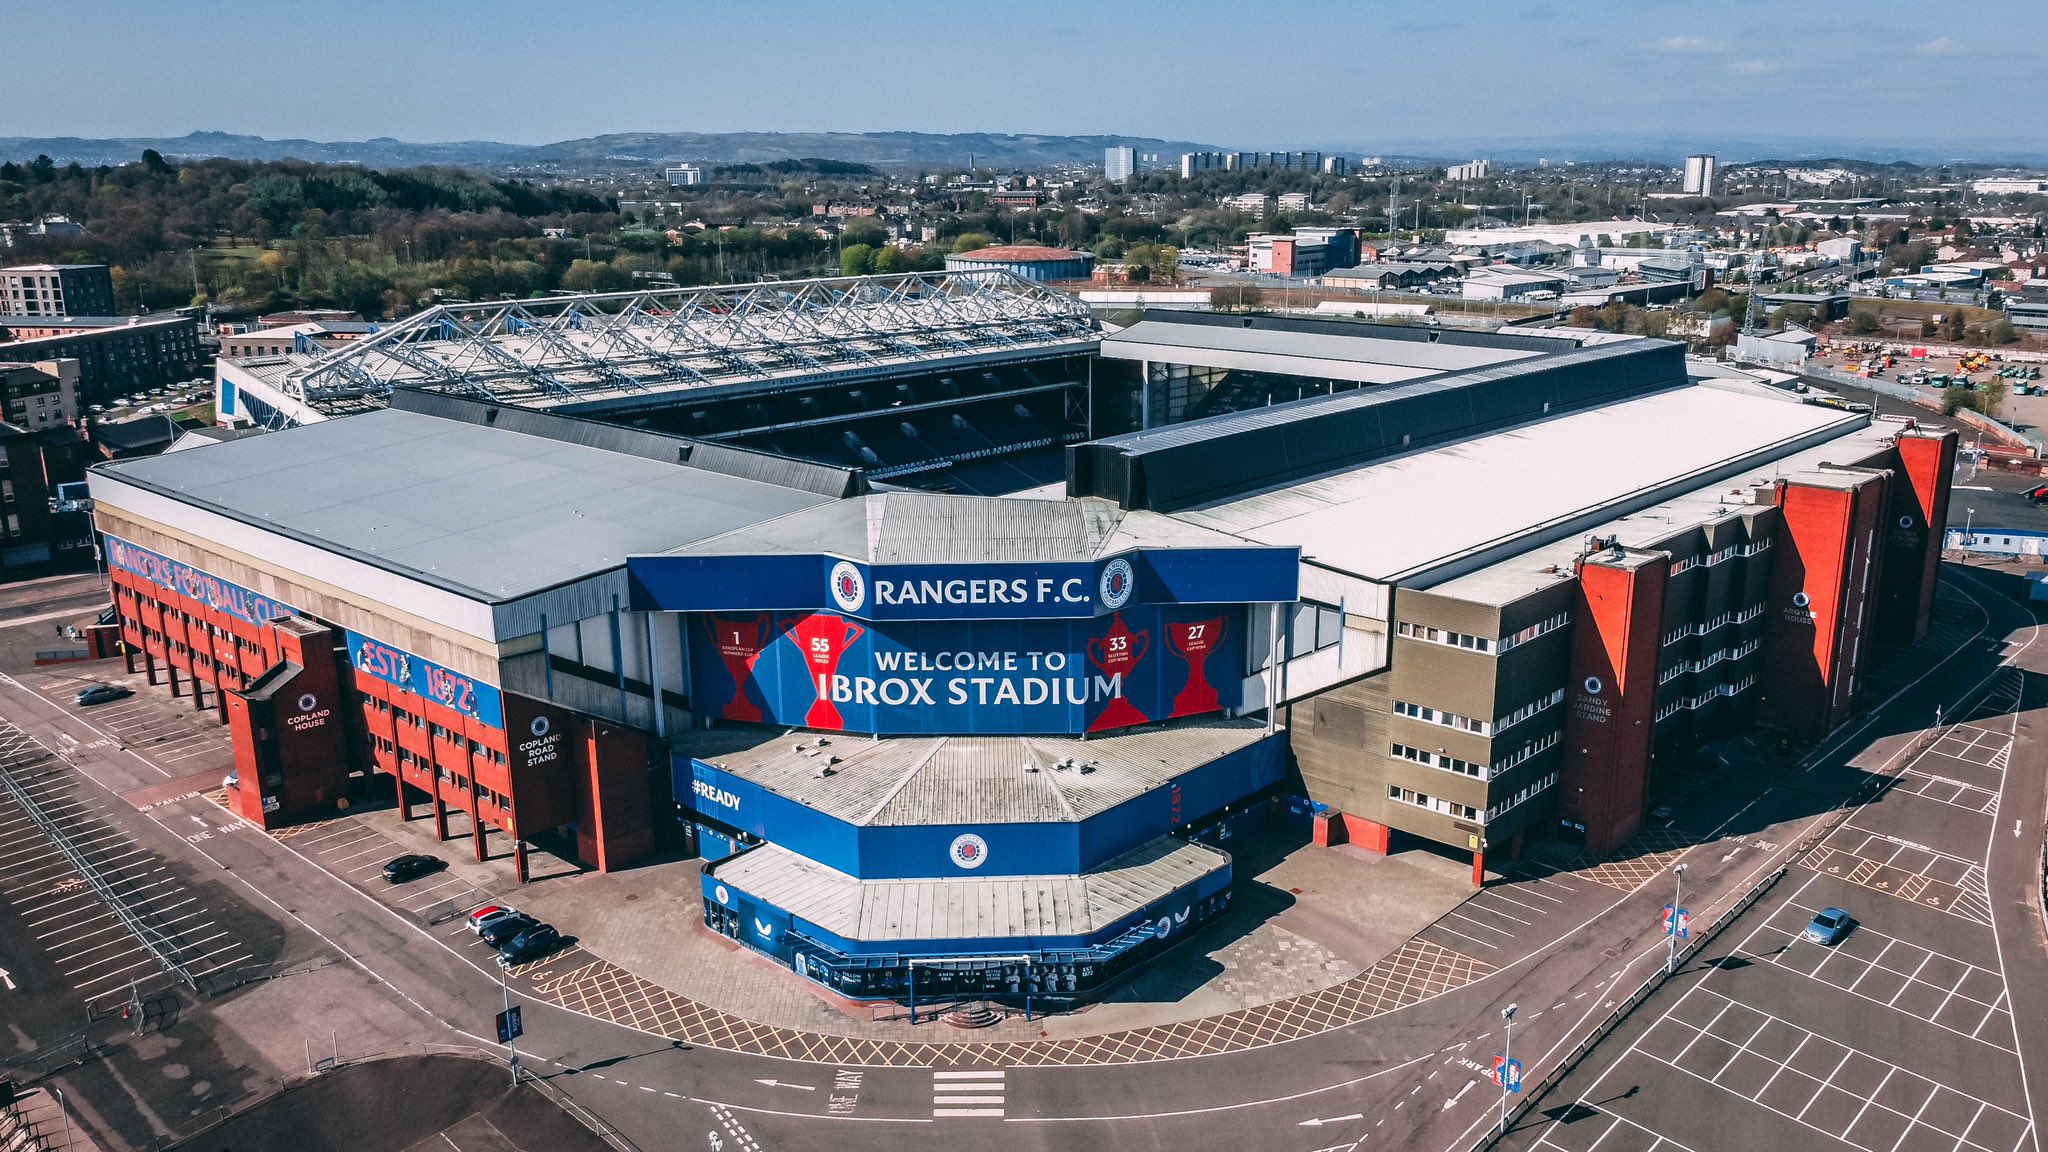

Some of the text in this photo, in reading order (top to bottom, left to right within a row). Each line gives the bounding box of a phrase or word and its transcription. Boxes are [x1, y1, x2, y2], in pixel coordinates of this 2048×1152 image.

[110, 540, 174, 583] RANGERS
[175, 566, 251, 618] FOOTBALL
[875, 579, 1028, 605] RANGERS
[1037, 578, 1090, 603] F.C.
[1785, 614, 1812, 625] HOUSE
[733, 632, 740, 645] 1
[1187, 625, 1205, 640] 27
[811, 638, 830, 652] 55
[1109, 636, 1127, 651] 33
[875, 651, 1066, 671] WELCOME TO
[424, 664, 470, 710] 1872
[819, 672, 1122, 706] IBROX STADIUM
[1576, 694, 1608, 706] SANDY
[1573, 702, 1612, 716] JARDINE
[287, 709, 330, 725] COPLAND
[295, 718, 325, 731] HOUSE
[1576, 711, 1606, 723] STAND
[519, 733, 561, 751] COPLAND
[528, 744, 555, 757] ROAD
[527, 752, 557, 767] STAND
[139, 791, 201, 812] NO PARKING
[692, 779, 741, 811] #READY
[1170, 786, 1181, 824] 1872
[186, 819, 247, 844] ONE WAY
[1749, 839, 1778, 852] ONE
[842, 975, 862, 983] FOLLOW
[833, 1069, 864, 1089] WAY
